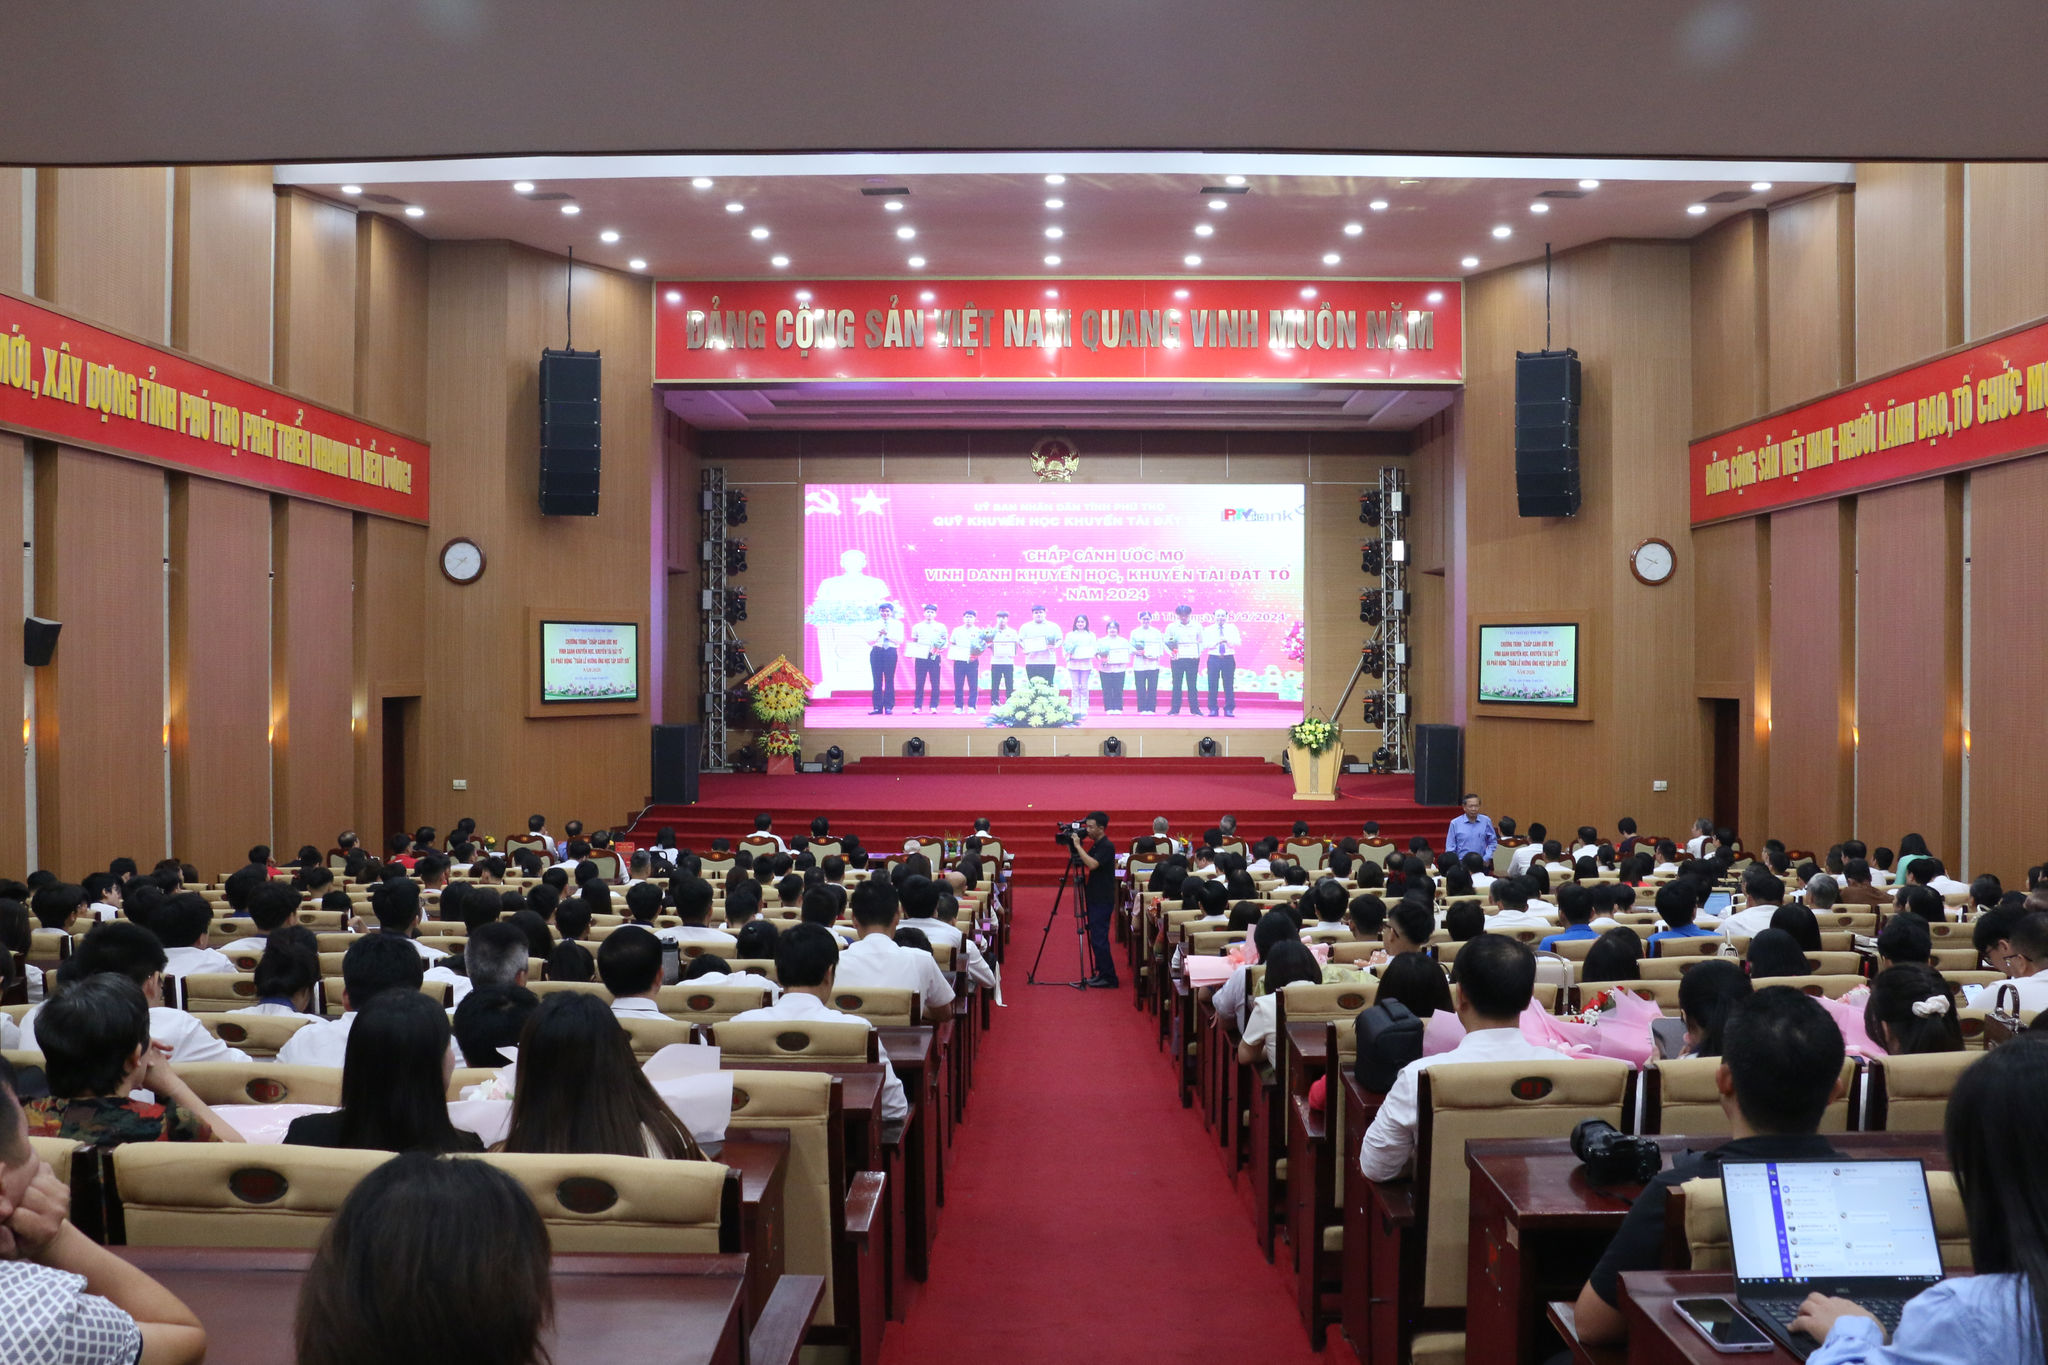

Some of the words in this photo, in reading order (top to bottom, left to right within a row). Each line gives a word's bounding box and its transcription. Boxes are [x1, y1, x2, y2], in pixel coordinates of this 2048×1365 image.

[687, 295, 766, 349] ĐẢNG
[775, 302, 855, 358] CỘNG
[865, 295, 925, 349] SẢN
[934, 302, 994, 356] VIỆT
[1004, 308, 1072, 348] NAM
[1081, 309, 1181, 352] QUANG
[1190, 309, 1259, 349] VINH
[1268, 302, 1357, 350] MUÔN
[1366, 301, 1434, 350] NĂM
[42, 341, 83, 405] XÂY
[86, 361, 137, 423] DỰNG
[139, 365, 177, 431] TỈNH
[180, 389, 210, 441] PHÚ
[212, 401, 240, 456] THỌ
[242, 409, 275, 458] PHÁT
[276, 408, 310, 467] TRIỂN
[312, 433, 348, 479] NHANH
[1705, 451, 1730, 496] ĐẢNG
[1731, 445, 1757, 496] CỘNG
[1758, 434, 1780, 482] SẢN
[1781, 429, 1805, 482] VIỆT
[1878, 398, 1915, 451] LÃNH
[1976, 359, 2023, 424] CHỨC
[932, 514, 963, 527] QUỸ
[967, 513, 1026, 527] KHUYẾN
[1028, 517, 1061, 528] HỌC
[1063, 513, 1124, 527] KHUYẾN
[1126, 514, 1150, 527] TÀI
[1073, 547, 1116, 562] CÁNH
[926, 569, 963, 581] VINH
[968, 569, 1011, 581] DANH
[1015, 565, 1081, 581] KHUYẾN
[1128, 565, 1192, 581] KHUYẾN
[1198, 566, 1225, 581] TÀI
[1230, 566, 1261, 581] ĐẤT
[1068, 586, 1103, 600] NĂM
[1107, 588, 1149, 600] 2024
